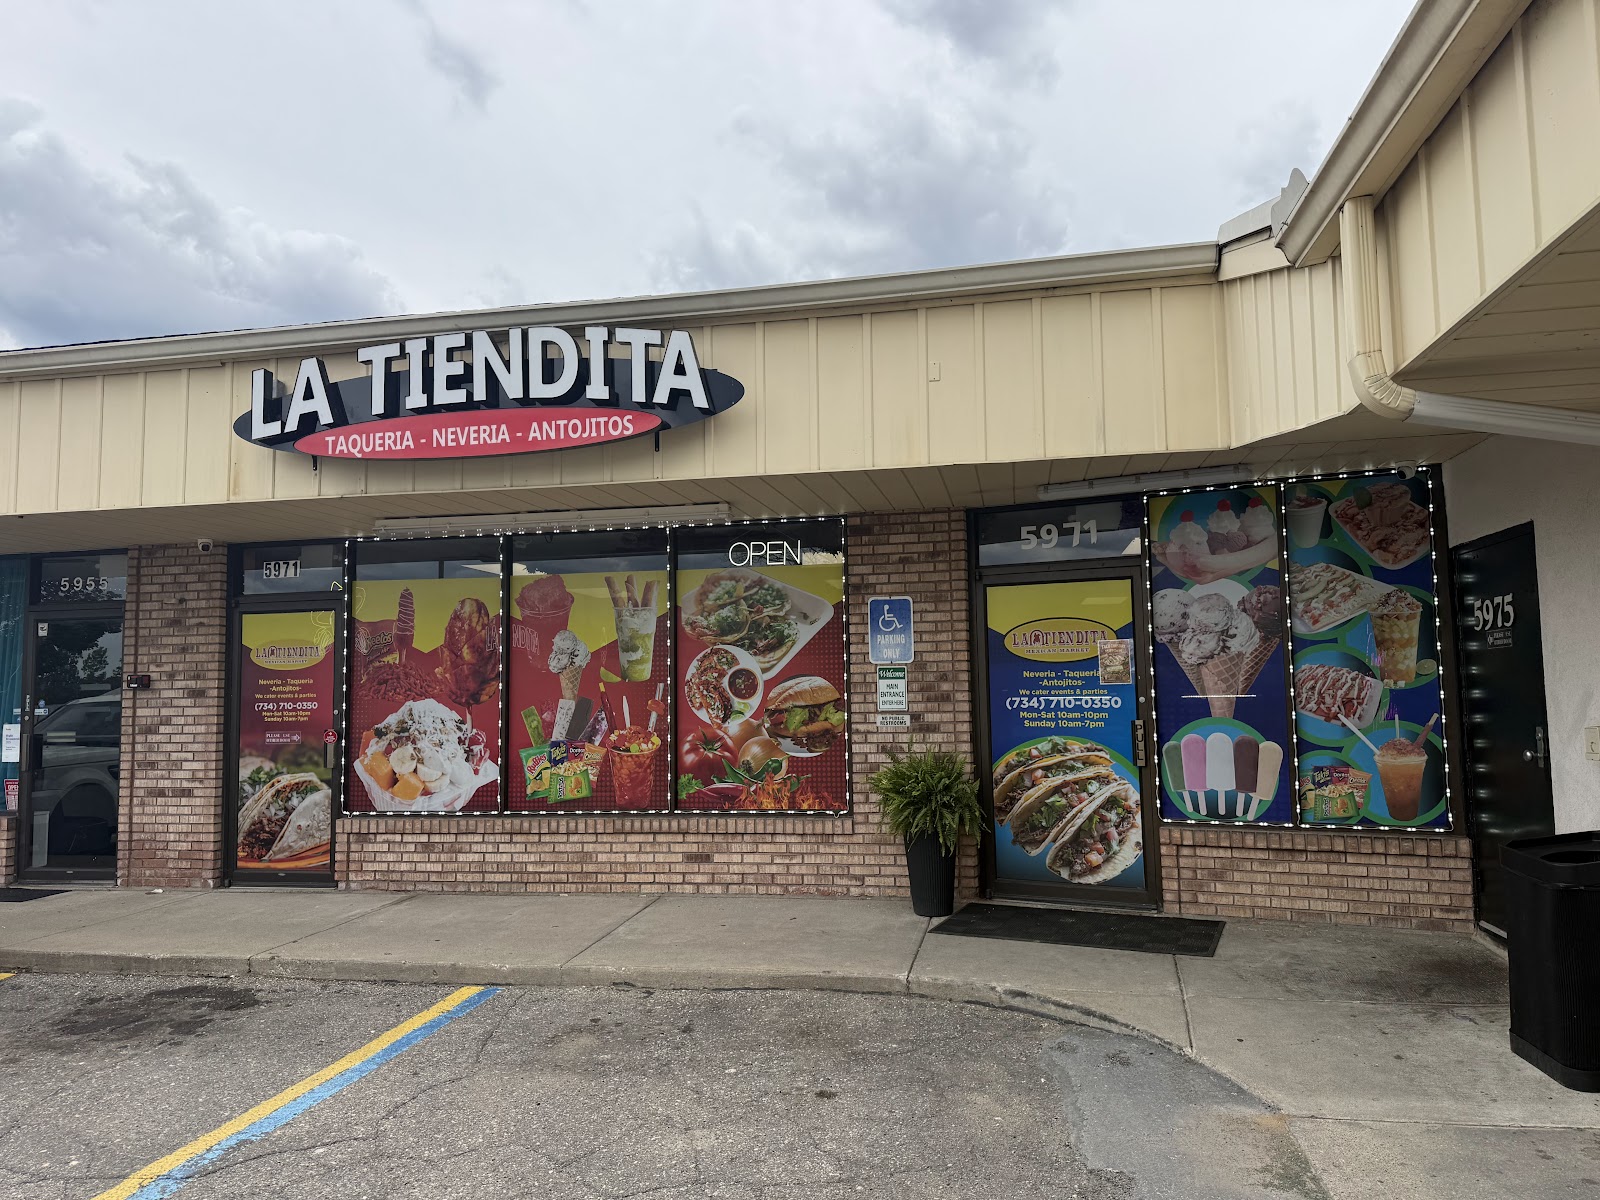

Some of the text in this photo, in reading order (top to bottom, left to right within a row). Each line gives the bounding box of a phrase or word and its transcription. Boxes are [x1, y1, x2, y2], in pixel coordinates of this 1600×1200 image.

[252, 326, 711, 440] LA TIENDITA
[325, 431, 414, 458] TAQUERIA
[432, 424, 510, 448] NEVERIA
[528, 415, 634, 441] ANTOJITOS
[1020, 519, 1098, 550] 5971
[729, 539, 801, 567] OPEN
[264, 562, 299, 578] 5971
[60, 577, 109, 592] 5955
[1474, 592, 1515, 631] 5975
[877, 634, 905, 645] PARKING
[1012, 630, 1108, 648] LA TIENDITA
[883, 648, 900, 659] ONLY
[878, 669, 905, 678] Welcome
[1023, 670, 1056, 678] Neveria
[1063, 669, 1100, 679] Taqueria
[1082, 688, 1108, 696] parties
[255, 702, 319, 711] (734) 710-0350
[1005, 696, 1122, 710] (734) 710-0350
[1019, 711, 1109, 720] Mon-Sat 10am-10pm
[1024, 719, 1105, 729] Sunday 10am-7pm
[1135, 723, 1144, 761] PULL
[526, 753, 547, 776] Ruffles
